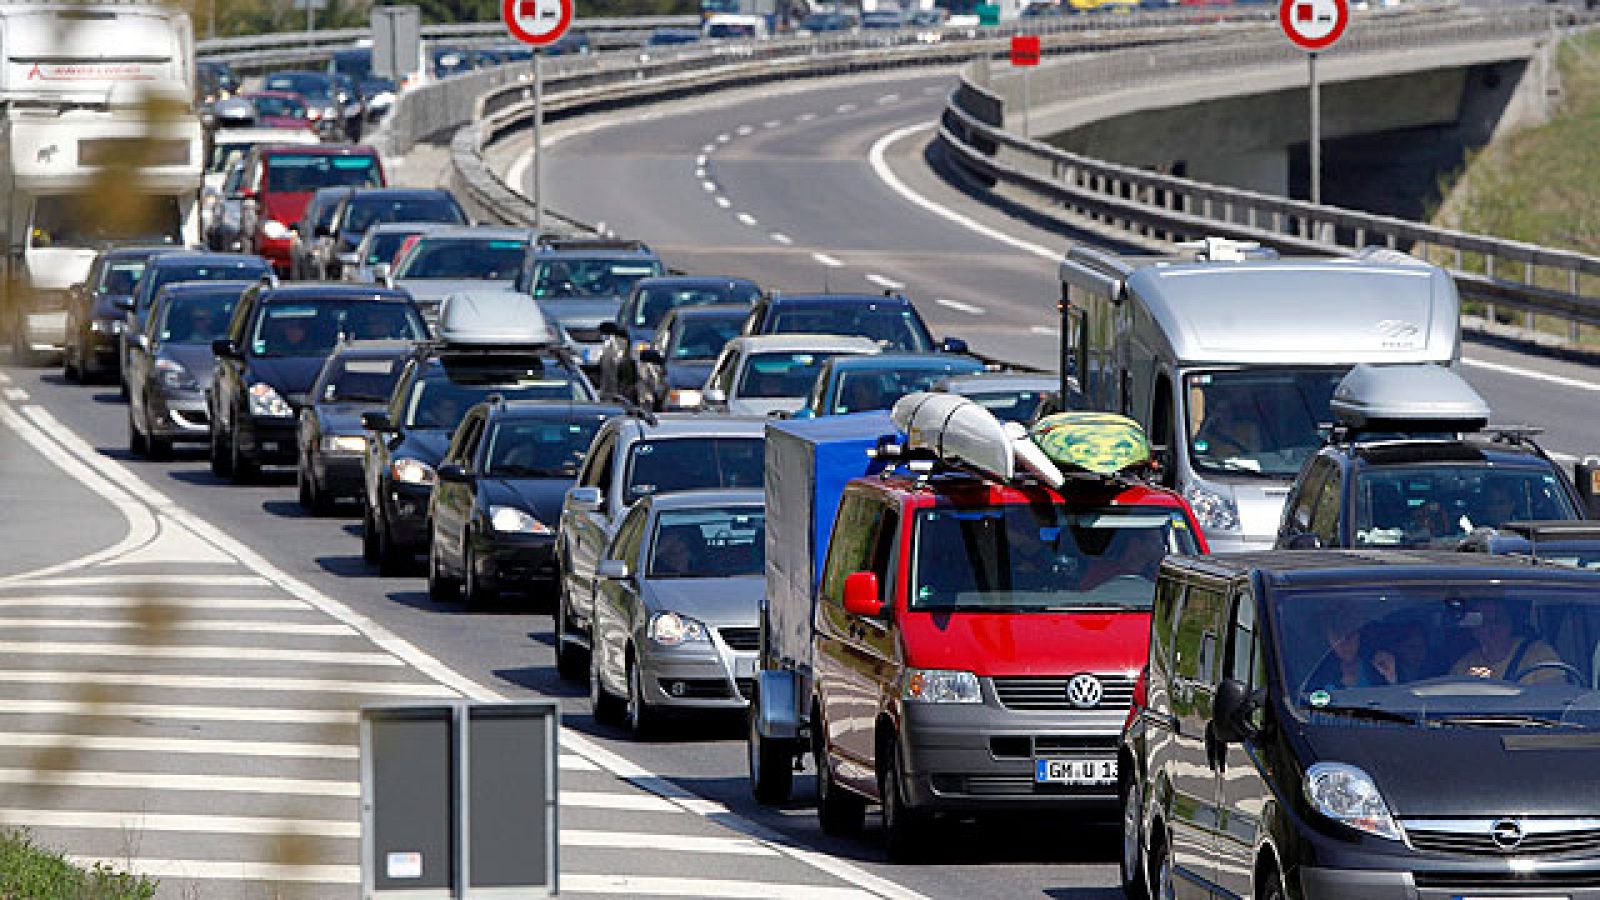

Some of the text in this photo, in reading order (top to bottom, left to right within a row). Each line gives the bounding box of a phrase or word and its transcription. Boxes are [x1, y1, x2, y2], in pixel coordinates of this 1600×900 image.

[1069, 674, 1100, 706] VW
[1049, 762, 1073, 778] GM
[1082, 762, 1095, 778] U
